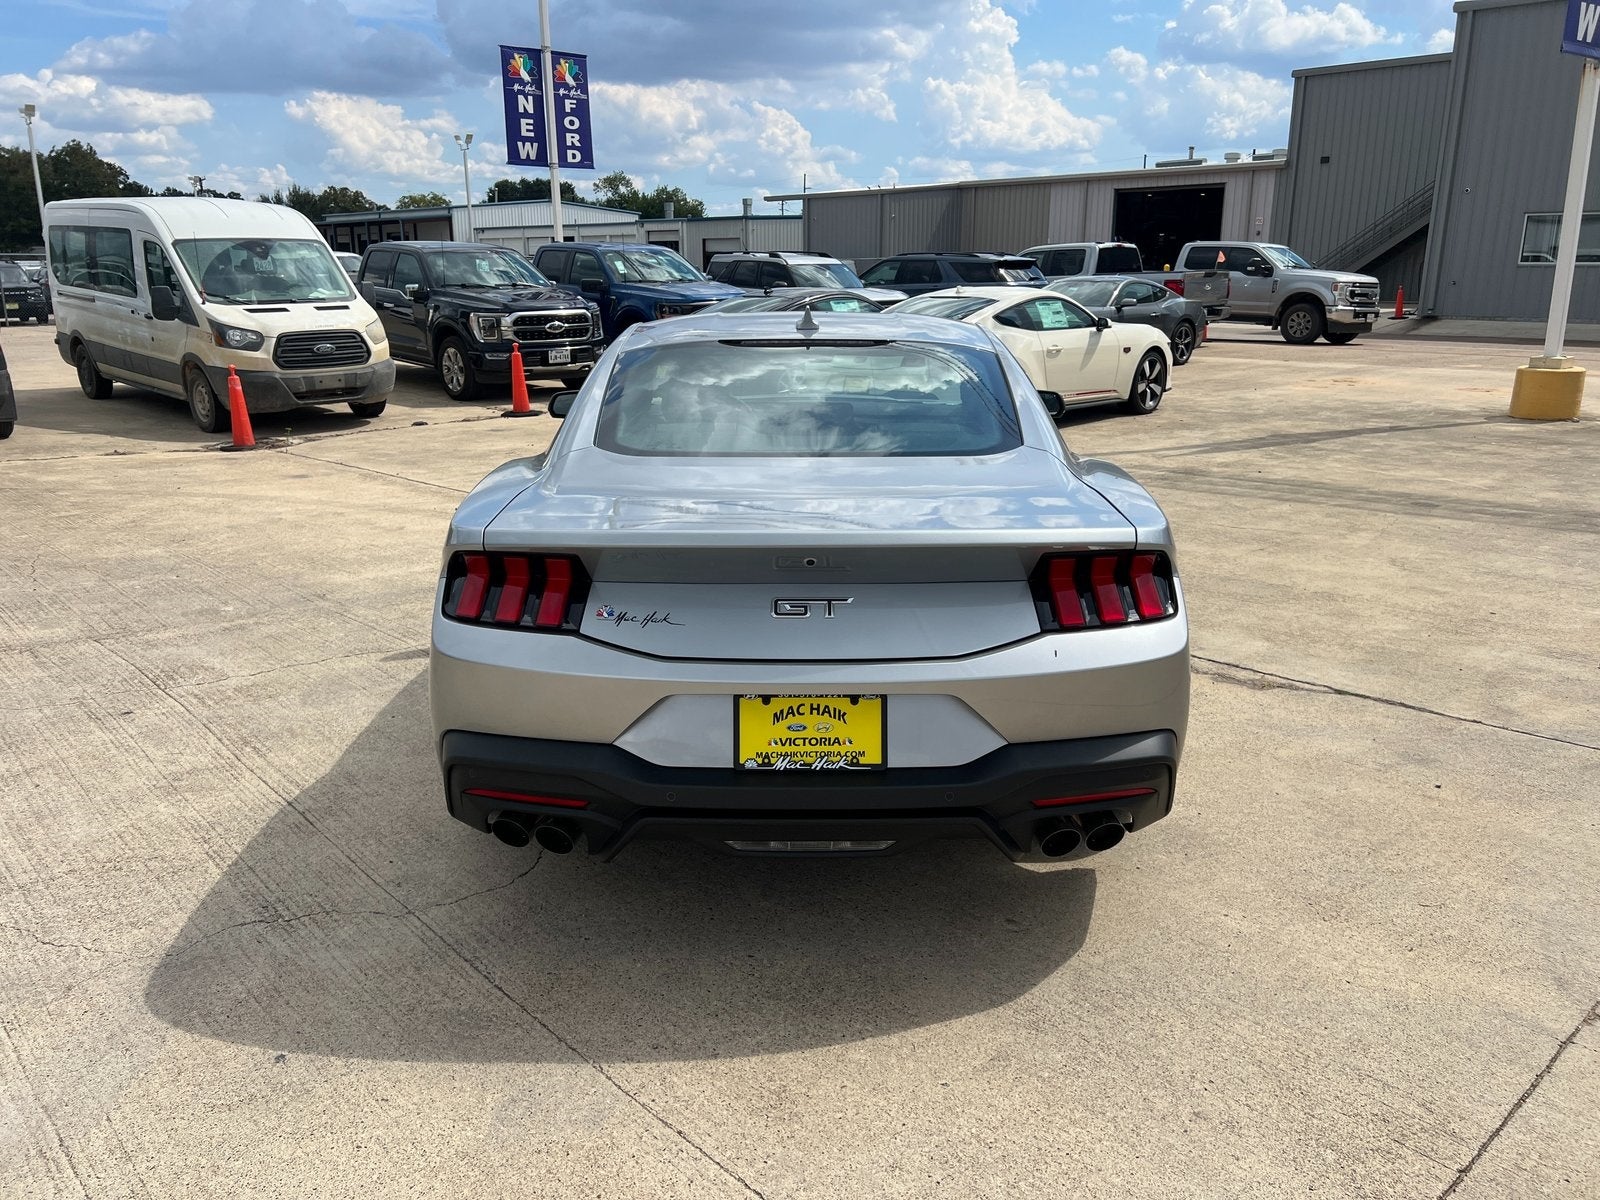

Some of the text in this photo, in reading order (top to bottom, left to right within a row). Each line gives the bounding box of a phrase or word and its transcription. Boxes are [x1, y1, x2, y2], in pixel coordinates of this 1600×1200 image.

[517, 95, 539, 161] NEW
[563, 98, 582, 163] FORD
[770, 597, 854, 618] GT
[613, 610, 678, 628] Mac Haik
[772, 703, 848, 725] MAC HAIK
[778, 737, 842, 746] VICTORIA
[755, 750, 866, 759] MACHAIKVICTORIA.COM
[772, 755, 852, 770] Mac Haik
